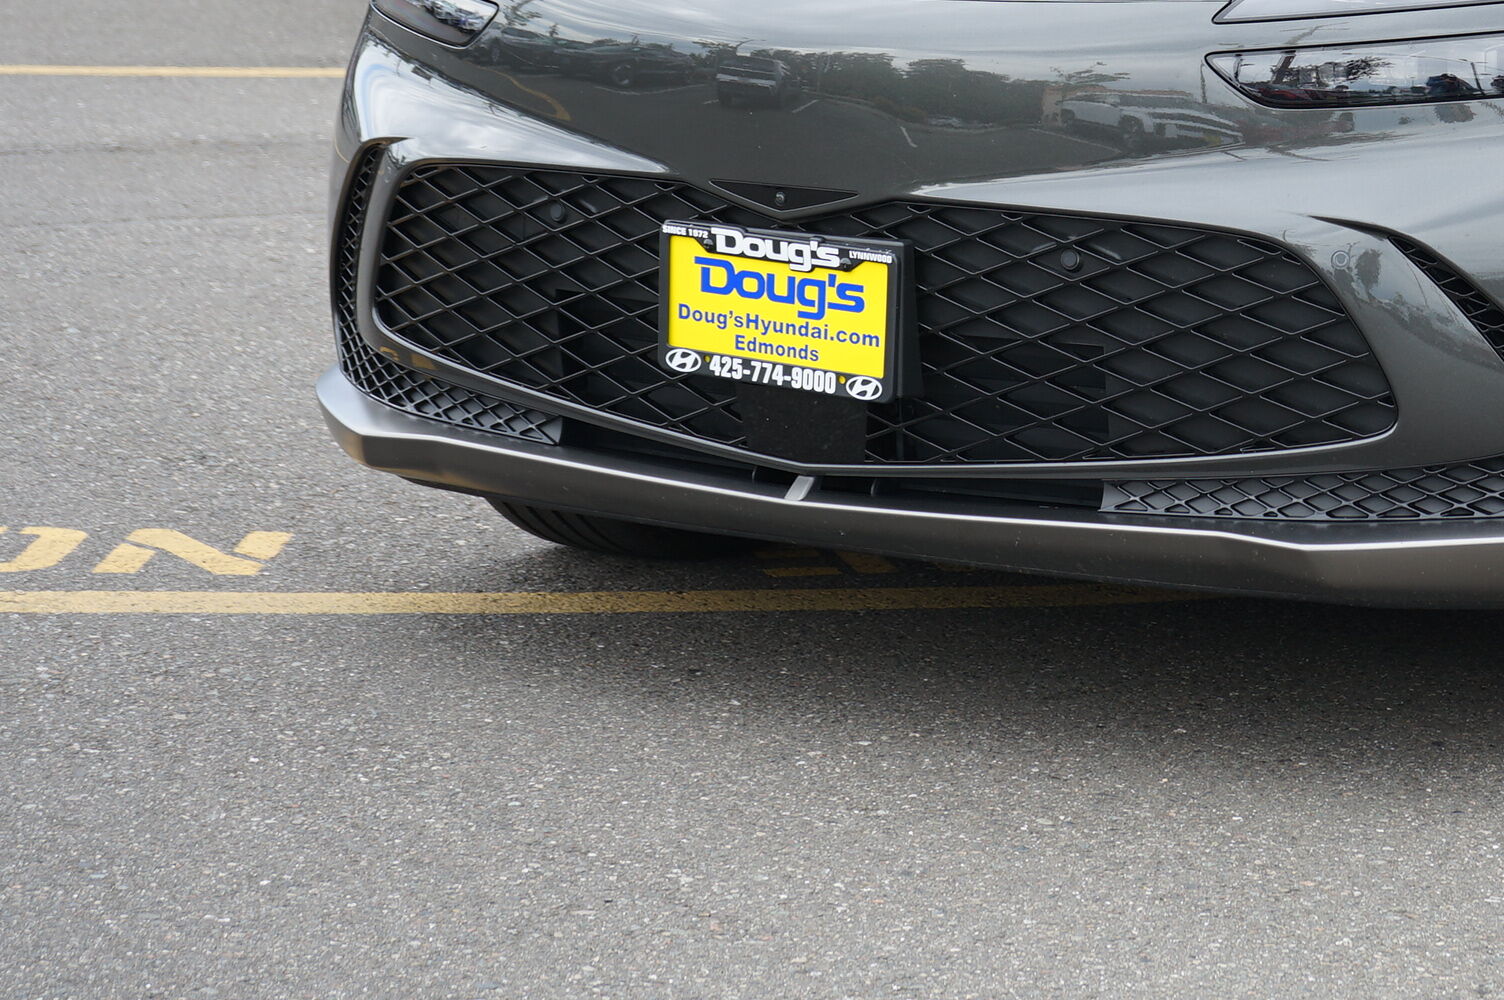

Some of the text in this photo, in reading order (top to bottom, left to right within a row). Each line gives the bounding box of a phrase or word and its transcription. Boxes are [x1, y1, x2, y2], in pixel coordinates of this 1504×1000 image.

[662, 225, 686, 236] SINCE
[710, 227, 841, 272] Doug's
[848, 250, 892, 264] LYNNWOOD
[694, 256, 865, 320] Doug's
[678, 303, 880, 348] Doug'sHyundai.com
[734, 334, 819, 362] Edmonds
[709, 355, 836, 394] 425-774-9000
